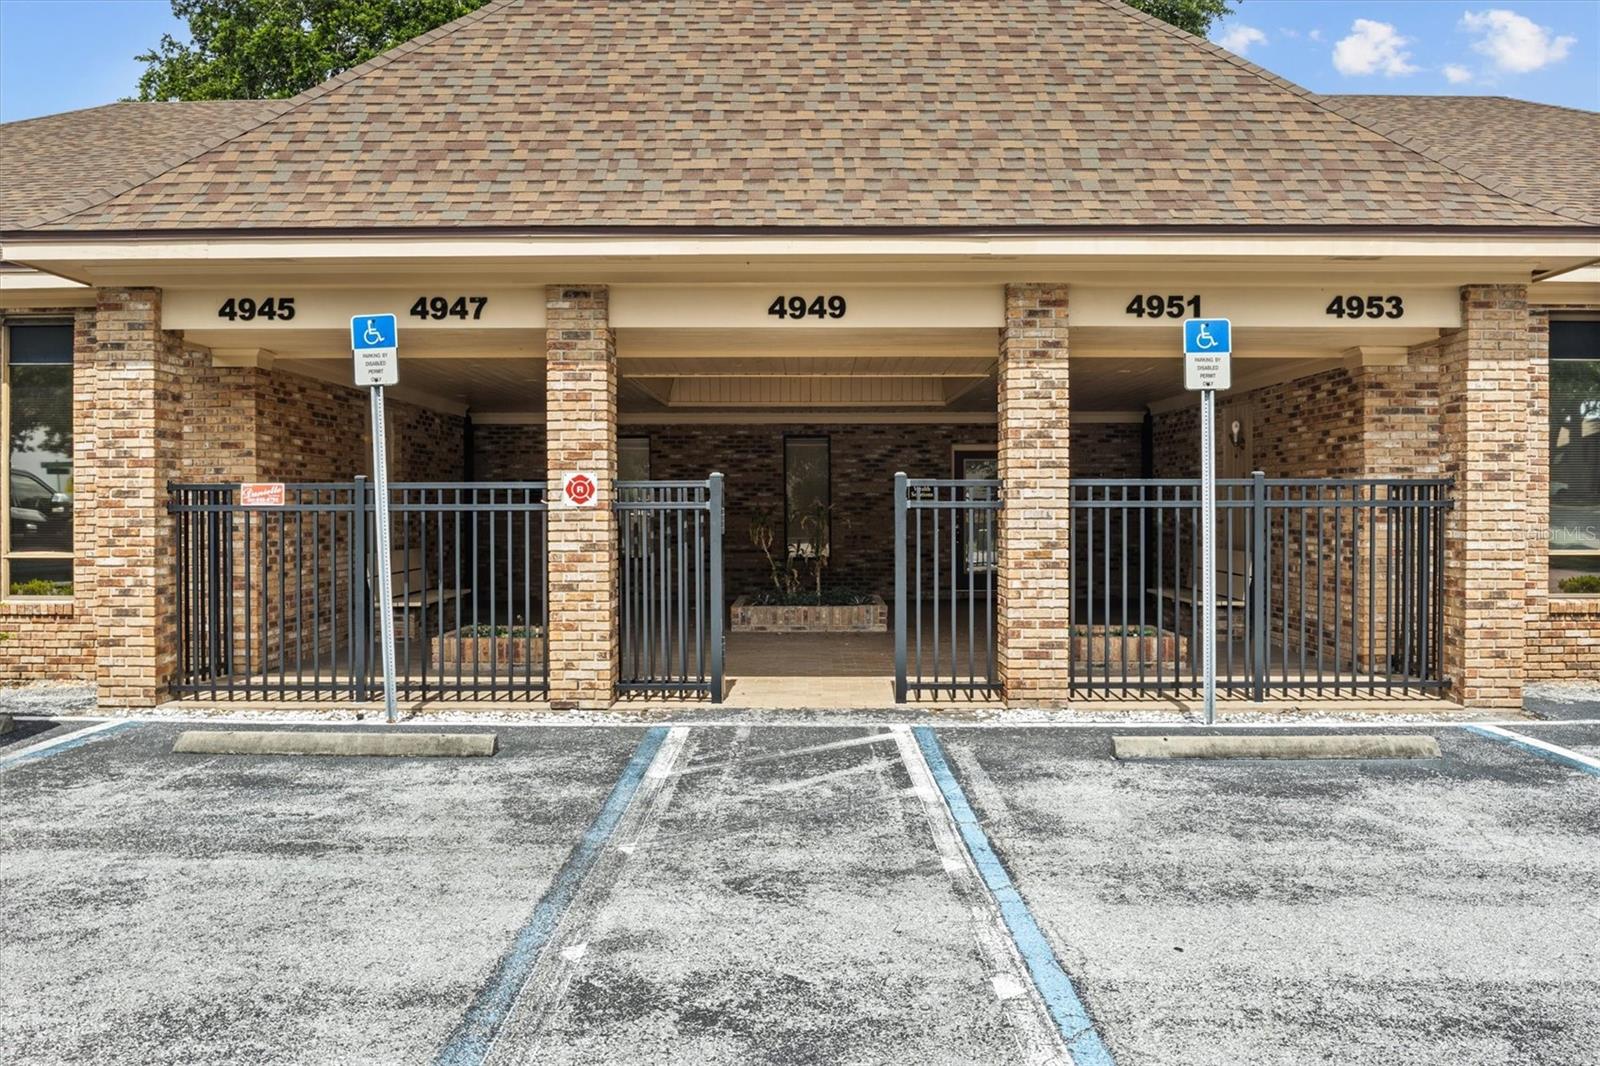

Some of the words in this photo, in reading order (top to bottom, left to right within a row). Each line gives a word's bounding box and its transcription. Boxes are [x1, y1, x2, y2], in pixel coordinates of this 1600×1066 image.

[218, 298, 295, 321] 4945
[410, 297, 488, 320] 4947
[768, 295, 846, 319] 4949
[1126, 295, 1201, 318] 4951
[1326, 295, 1404, 319] 4953
